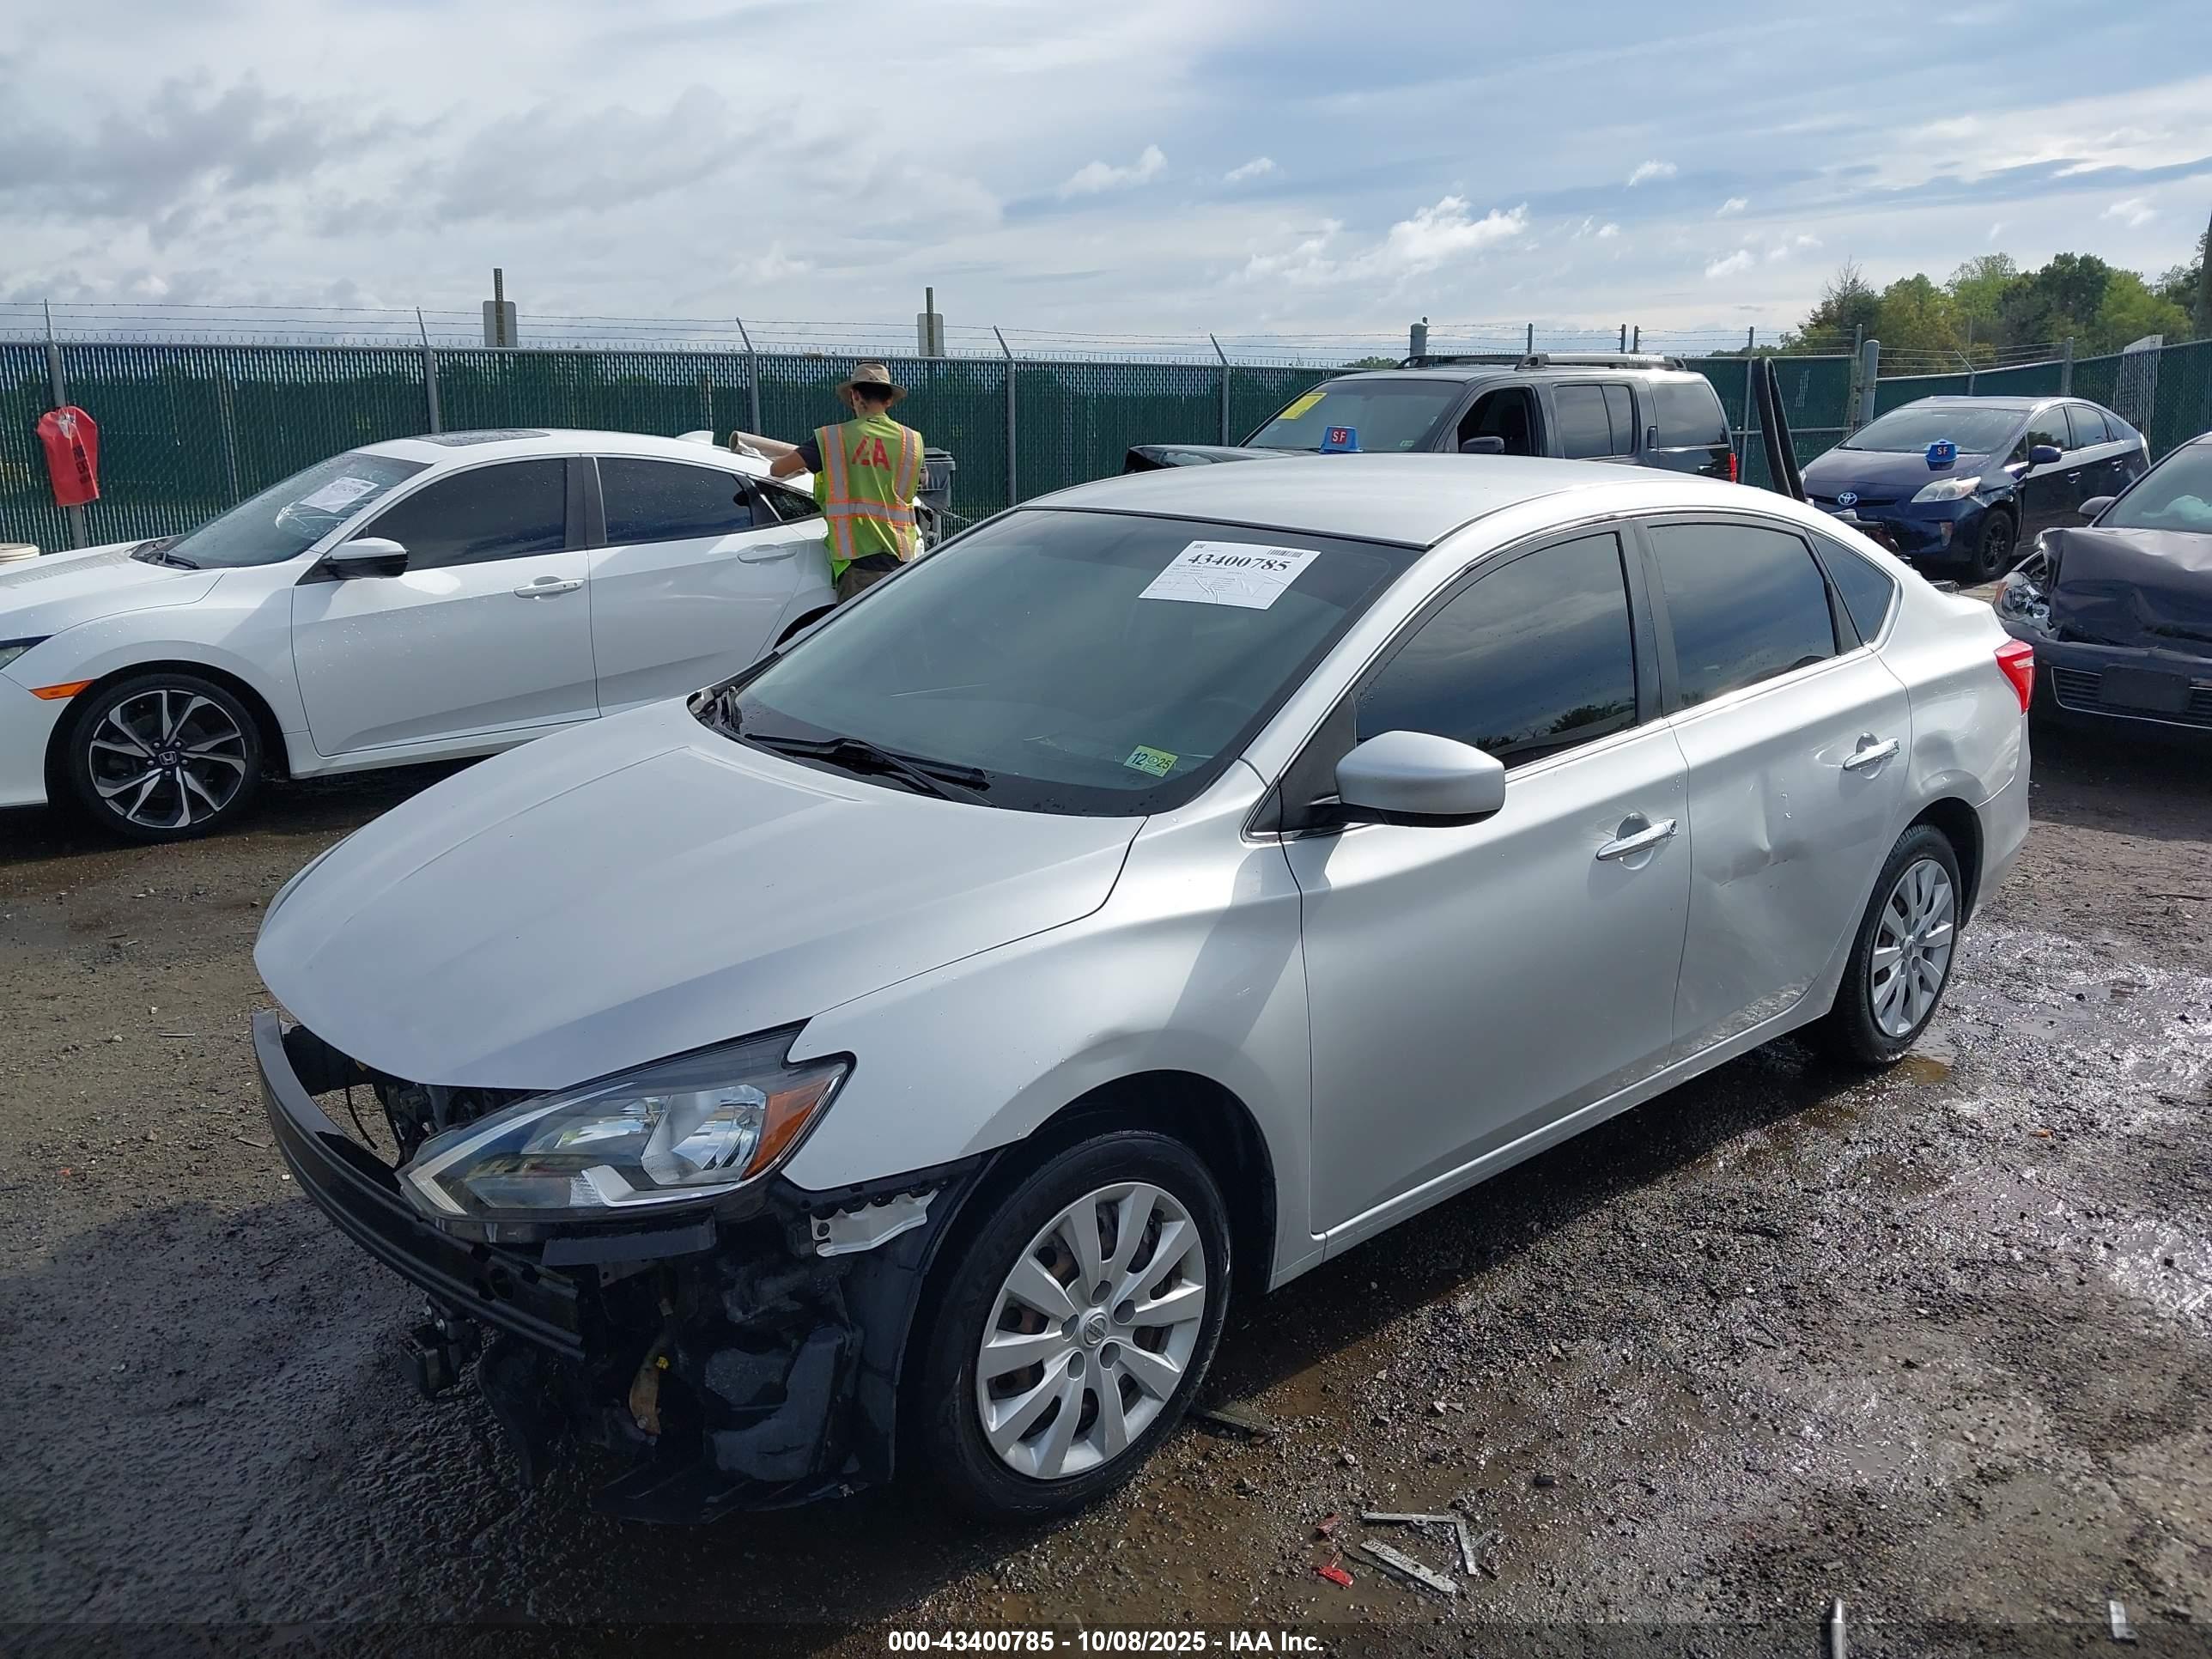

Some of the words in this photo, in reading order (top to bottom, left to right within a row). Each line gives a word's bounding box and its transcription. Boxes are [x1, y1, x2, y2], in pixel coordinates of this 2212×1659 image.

[1332, 431, 1346, 442] SF
[1937, 447, 1948, 455] SF
[1188, 554, 1292, 572] 43400785
[1131, 751, 1148, 766] 12
[1156, 757, 1172, 769] 25
